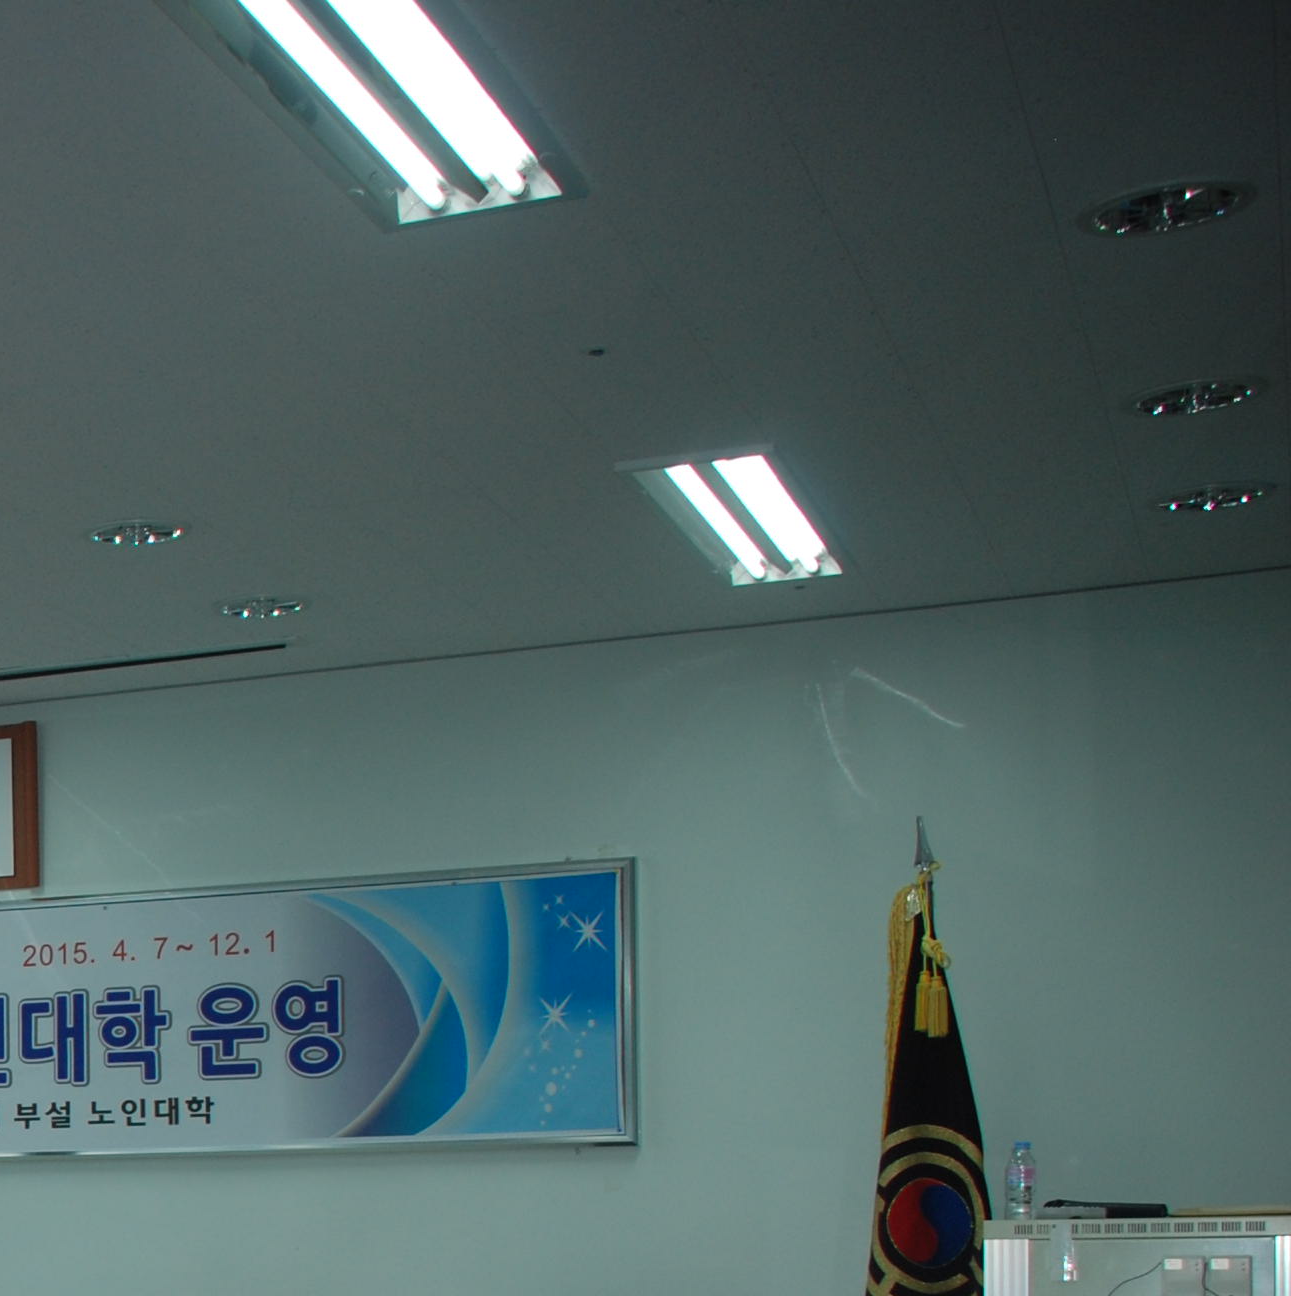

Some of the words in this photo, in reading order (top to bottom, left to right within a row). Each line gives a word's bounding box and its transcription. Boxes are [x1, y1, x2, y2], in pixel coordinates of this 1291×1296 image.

[22, 941, 96, 968] 2015.
[111, 938, 136, 962] 4.
[264, 929, 277, 953] 1
[187, 974, 347, 1081] 운영
[13, 1100, 72, 1130] 부설
[87, 1096, 216, 1127] 노인대학
